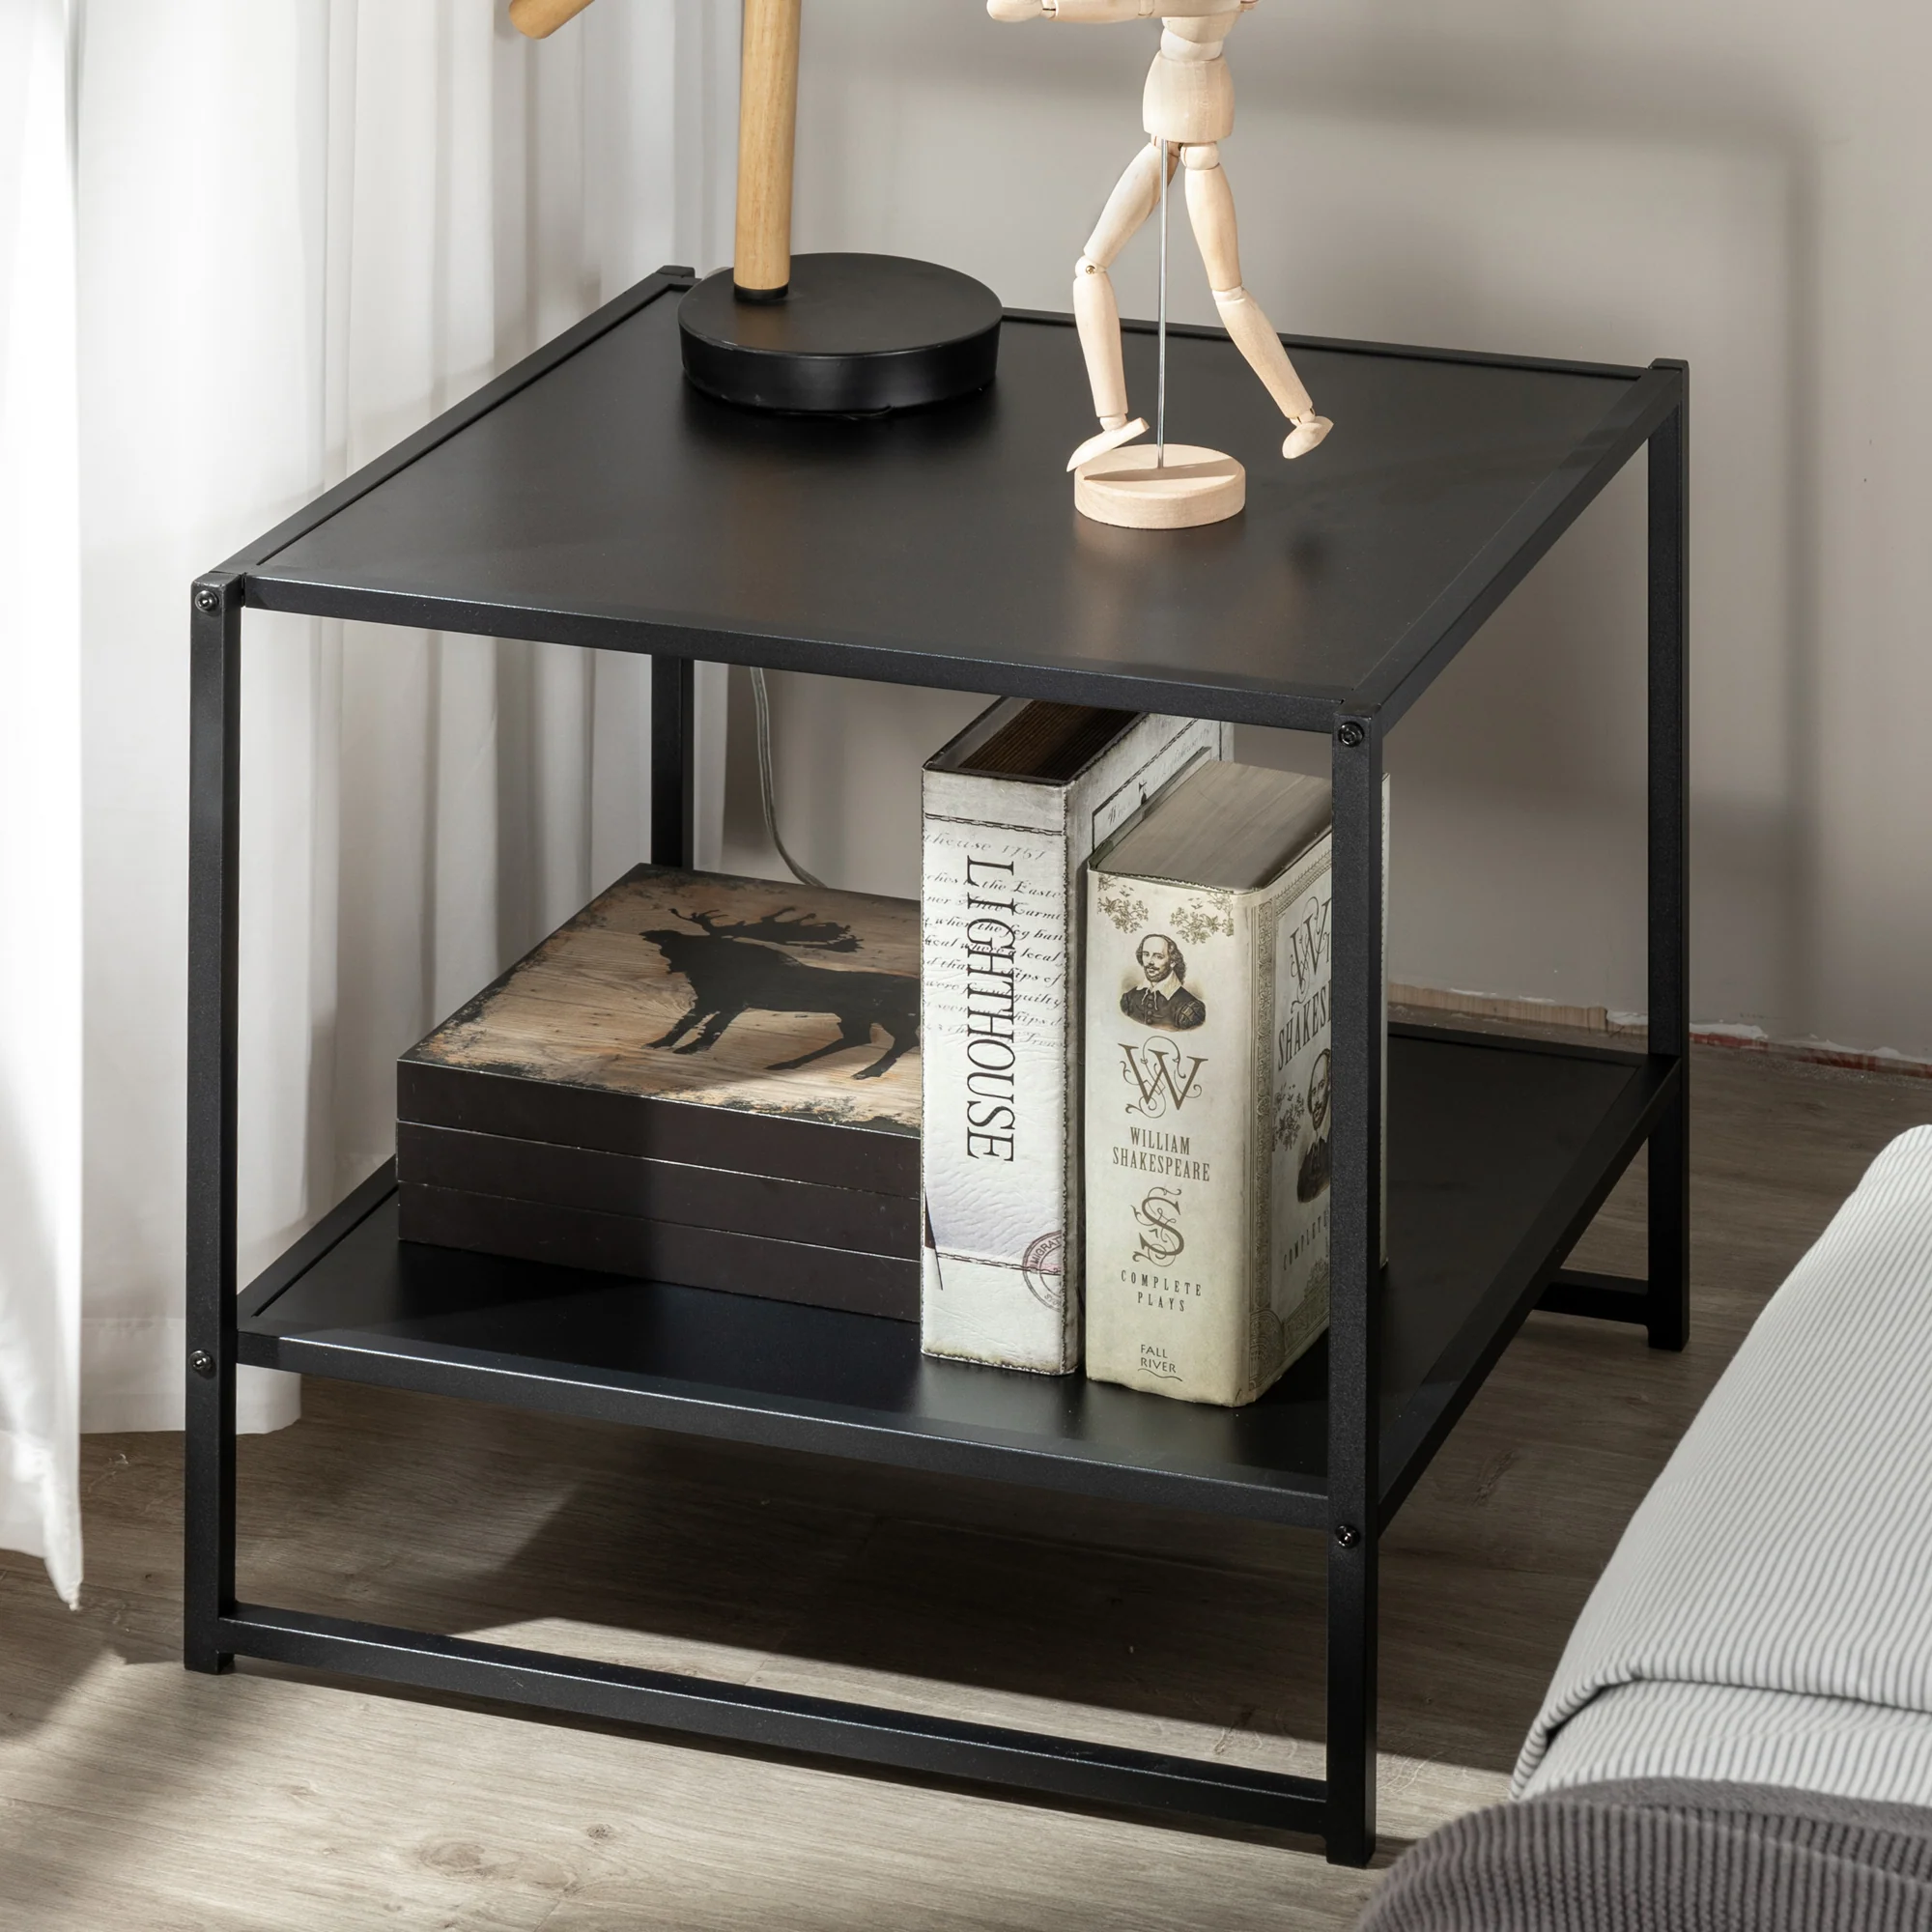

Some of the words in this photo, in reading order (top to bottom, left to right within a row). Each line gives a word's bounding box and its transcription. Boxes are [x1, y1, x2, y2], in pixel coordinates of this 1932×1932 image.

[966, 855, 1015, 1162] LIGHTHOUSE
[1118, 1037, 1209, 1118] W
[1129, 1126, 1191, 1156] WILLIAM
[1112, 1146, 1210, 1182] SHAKESPEARE
[1121, 1268, 1203, 1297] COMPLETE
[1137, 1291, 1185, 1313] PLAYS
[1140, 1343, 1169, 1360] FALL
[1140, 1356, 1178, 1375] RIVER
